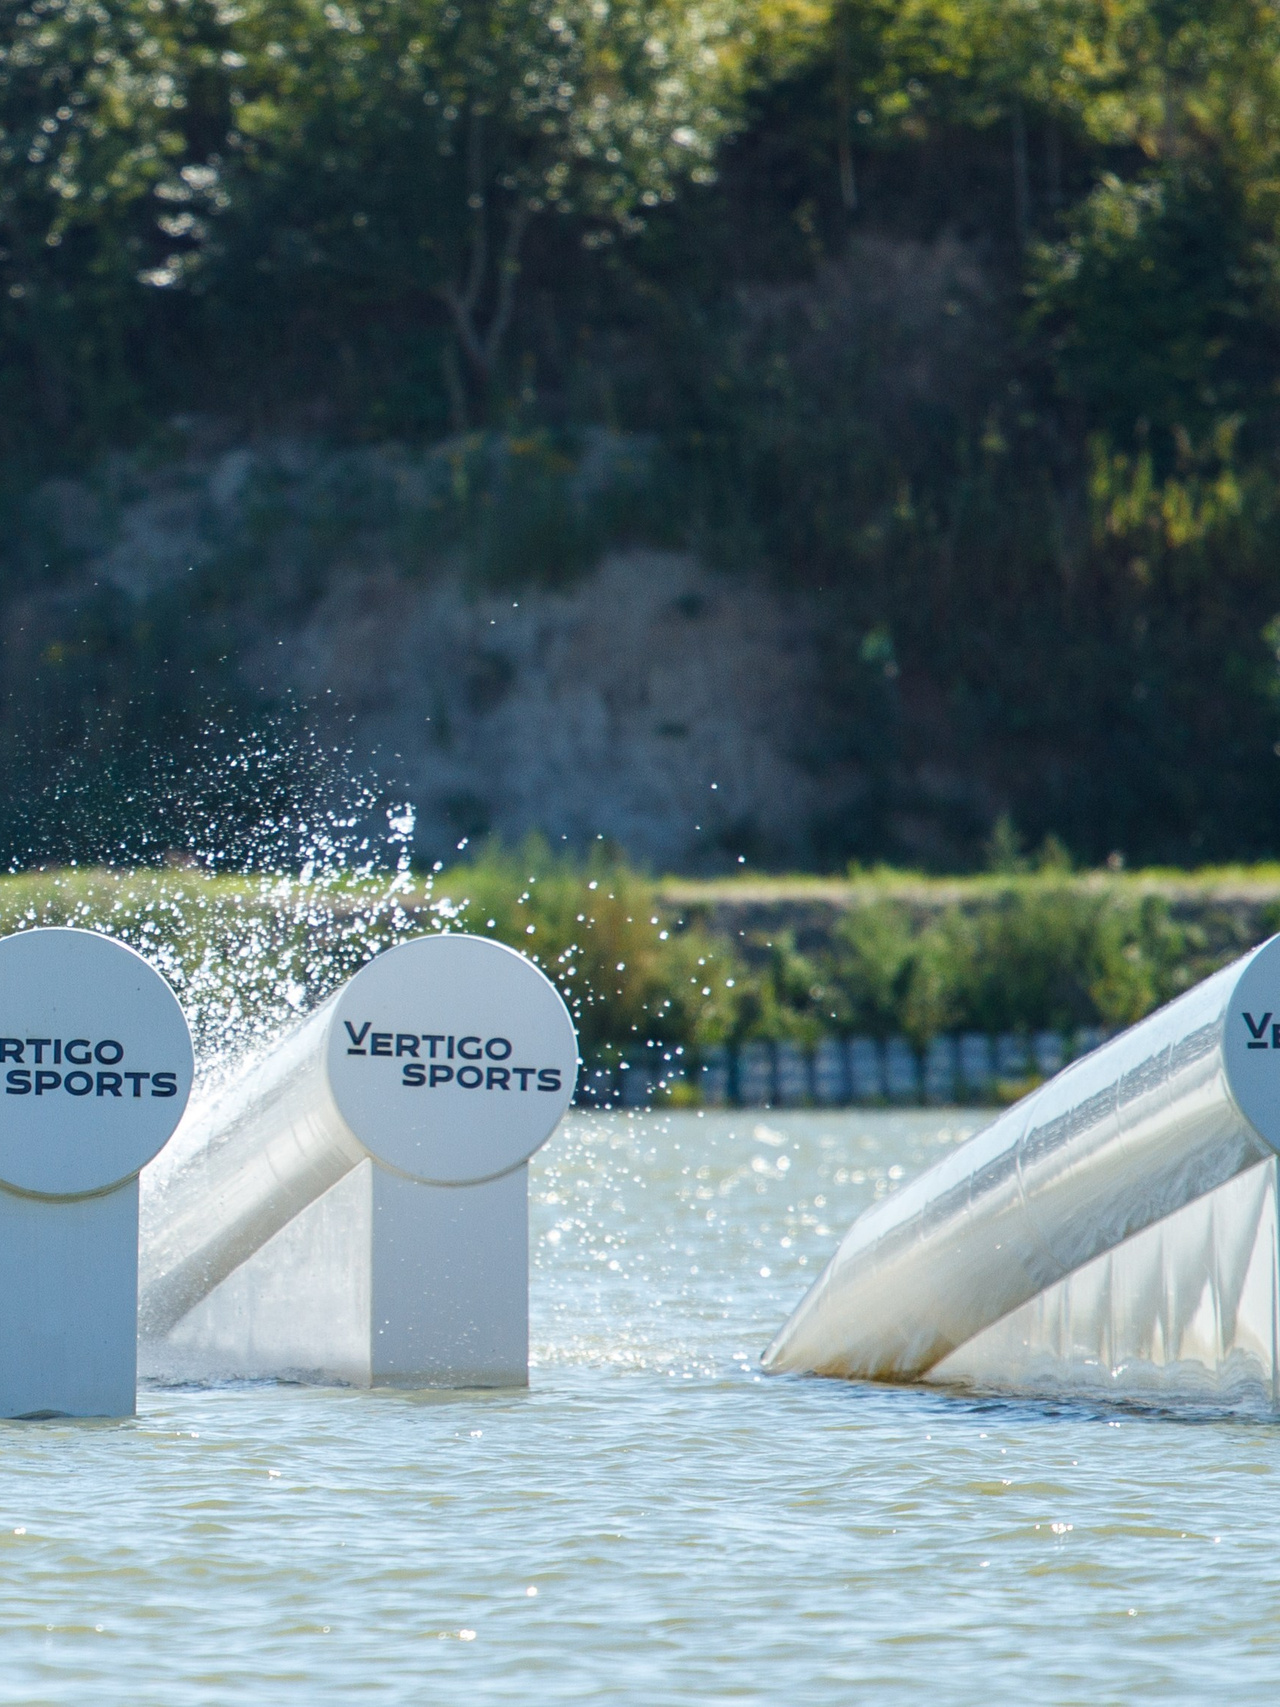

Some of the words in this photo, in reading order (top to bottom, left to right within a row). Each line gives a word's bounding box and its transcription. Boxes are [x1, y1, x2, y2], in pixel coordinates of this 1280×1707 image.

[344, 1021, 512, 1061] VERTIGO
[6, 1070, 178, 1098] SPORTS
[402, 1063, 562, 1092] SPORTS
